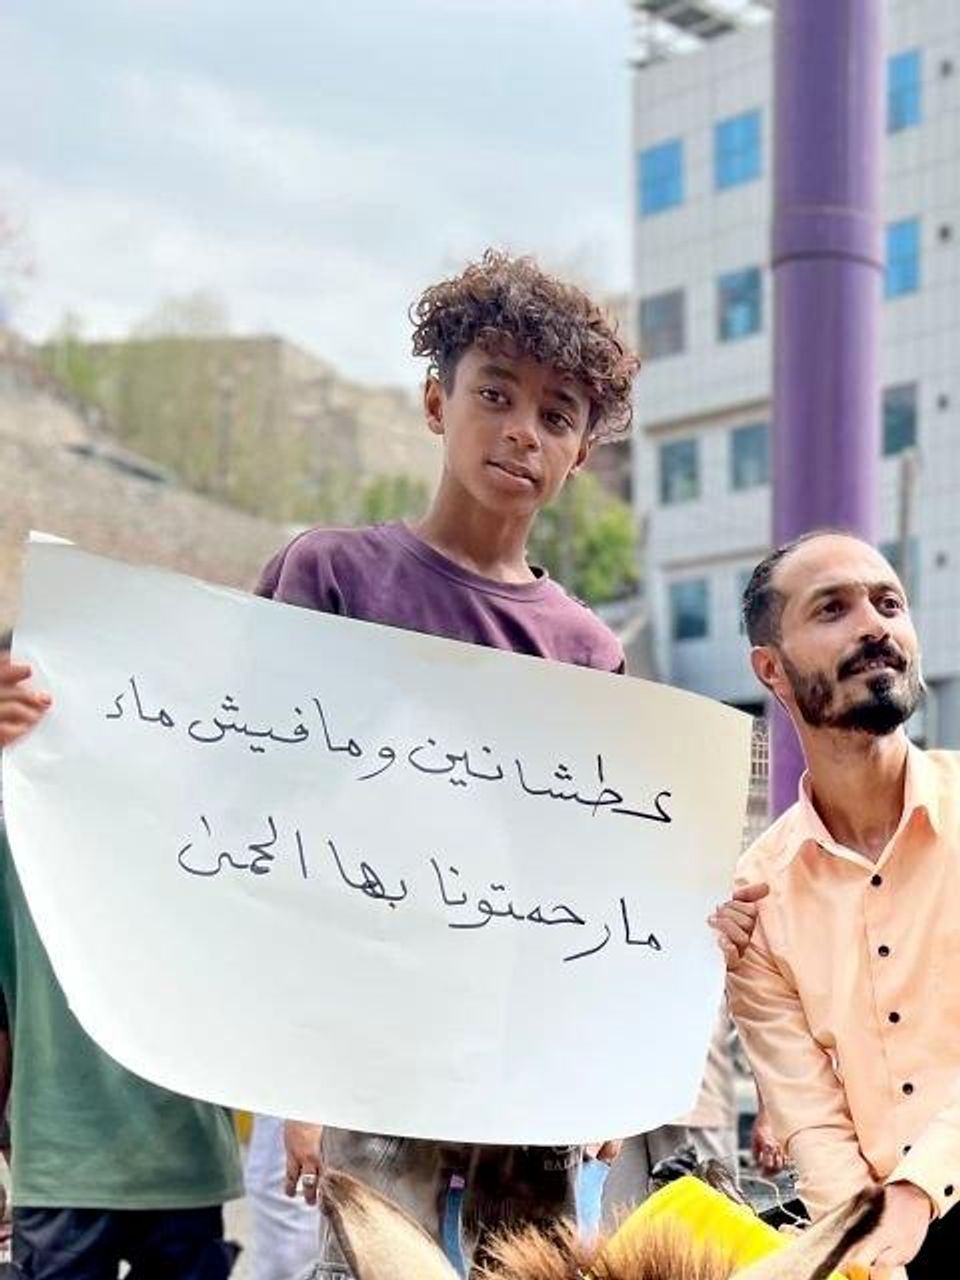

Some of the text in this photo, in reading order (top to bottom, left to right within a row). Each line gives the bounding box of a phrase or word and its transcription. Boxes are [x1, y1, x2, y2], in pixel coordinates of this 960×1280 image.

[105, 676, 175, 729] ماء
[407, 738, 673, 824] عطشانين
[327, 838, 408, 910] بها
